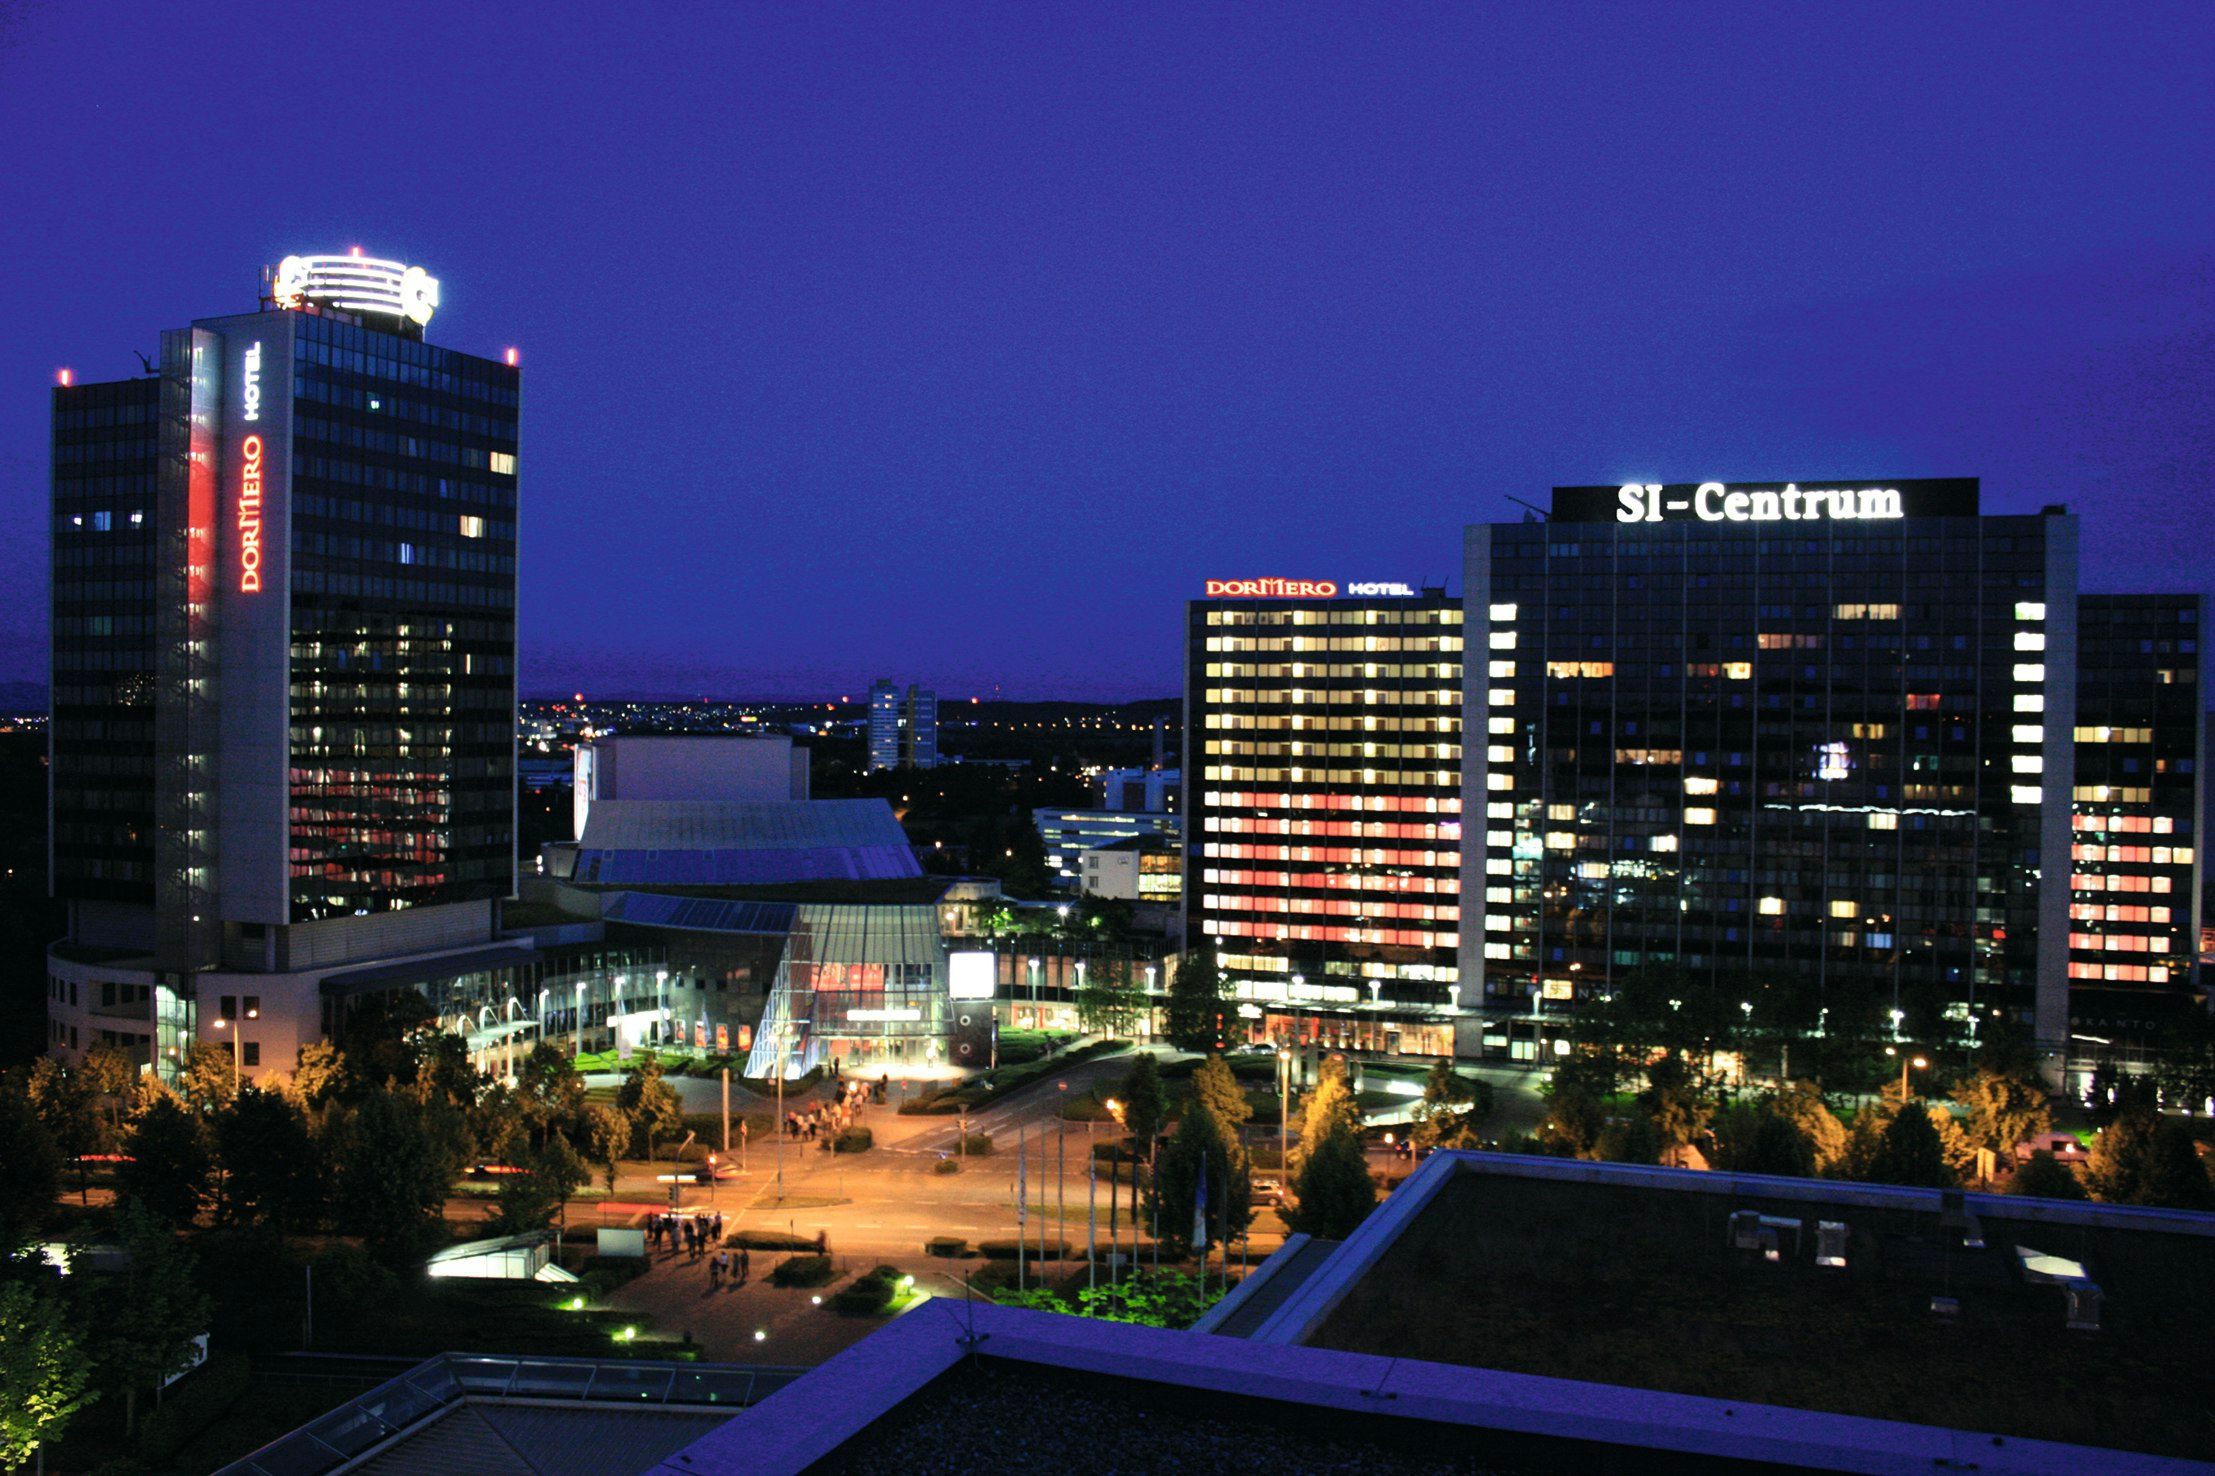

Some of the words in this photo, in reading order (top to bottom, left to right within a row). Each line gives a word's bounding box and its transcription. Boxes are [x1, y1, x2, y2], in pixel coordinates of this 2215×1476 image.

[243, 341, 262, 422] HOTEL
[238, 435, 262, 593] DORMERO
[1616, 482, 1904, 523] SI-Centrum
[1206, 578, 1337, 597] DORMERO
[1347, 582, 1415, 596] HOTEL
